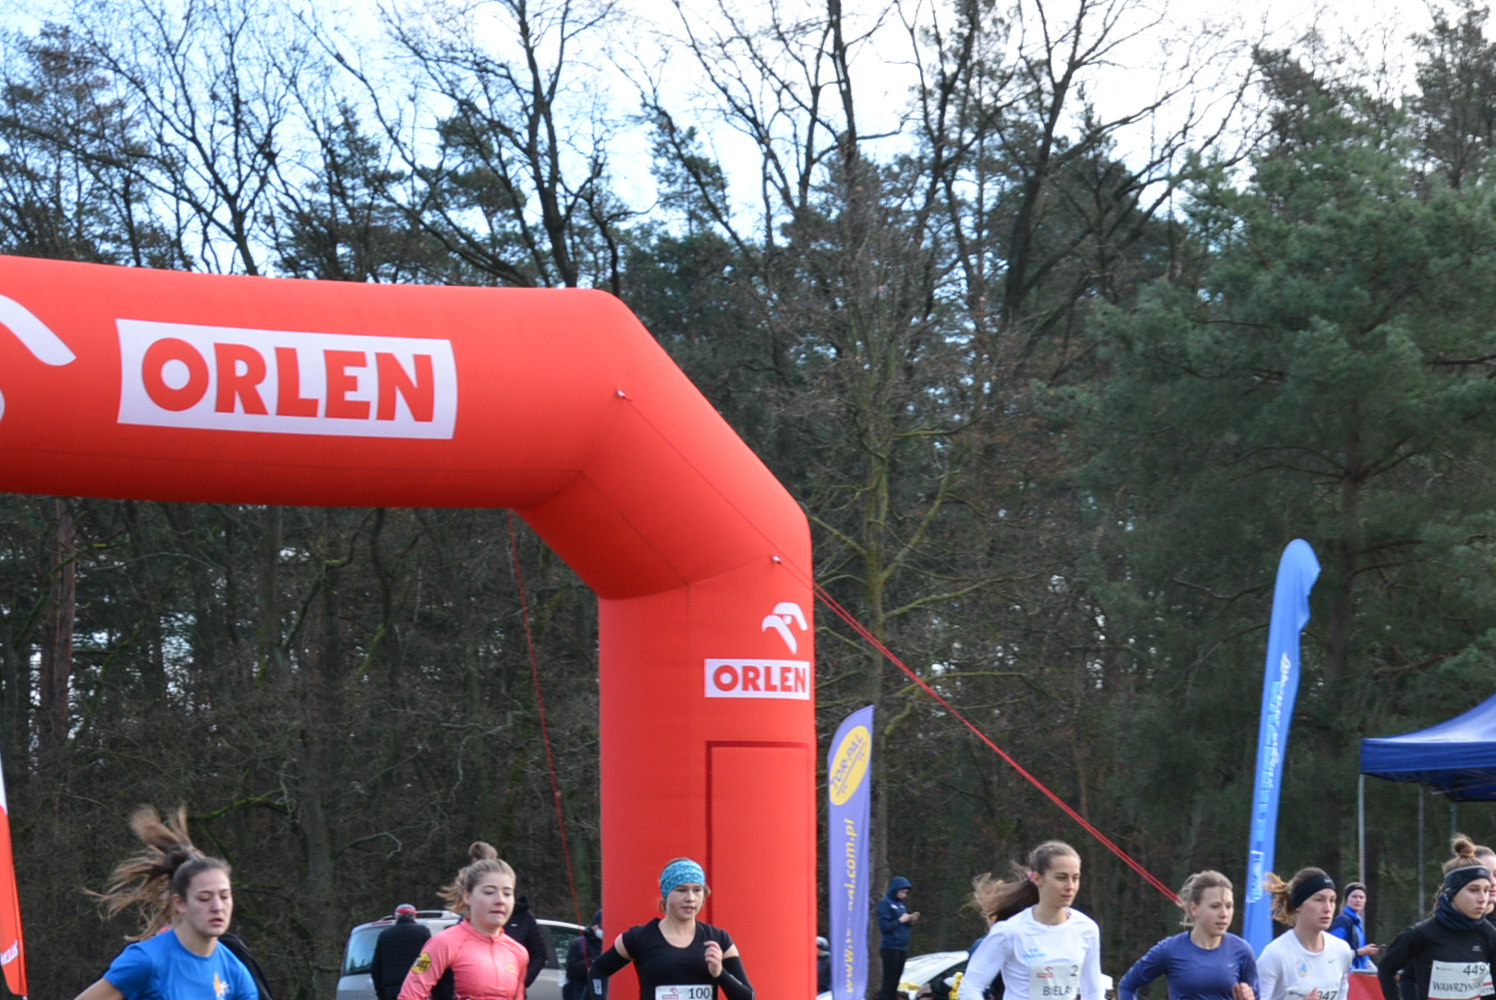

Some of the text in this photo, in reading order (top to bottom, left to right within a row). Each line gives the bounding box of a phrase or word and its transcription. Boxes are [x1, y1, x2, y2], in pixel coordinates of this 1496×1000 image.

[141, 337, 435, 422] ORLEN
[713, 664, 806, 693] ORLEN
[1463, 965, 1486, 976] 449
[689, 988, 711, 999] 100
